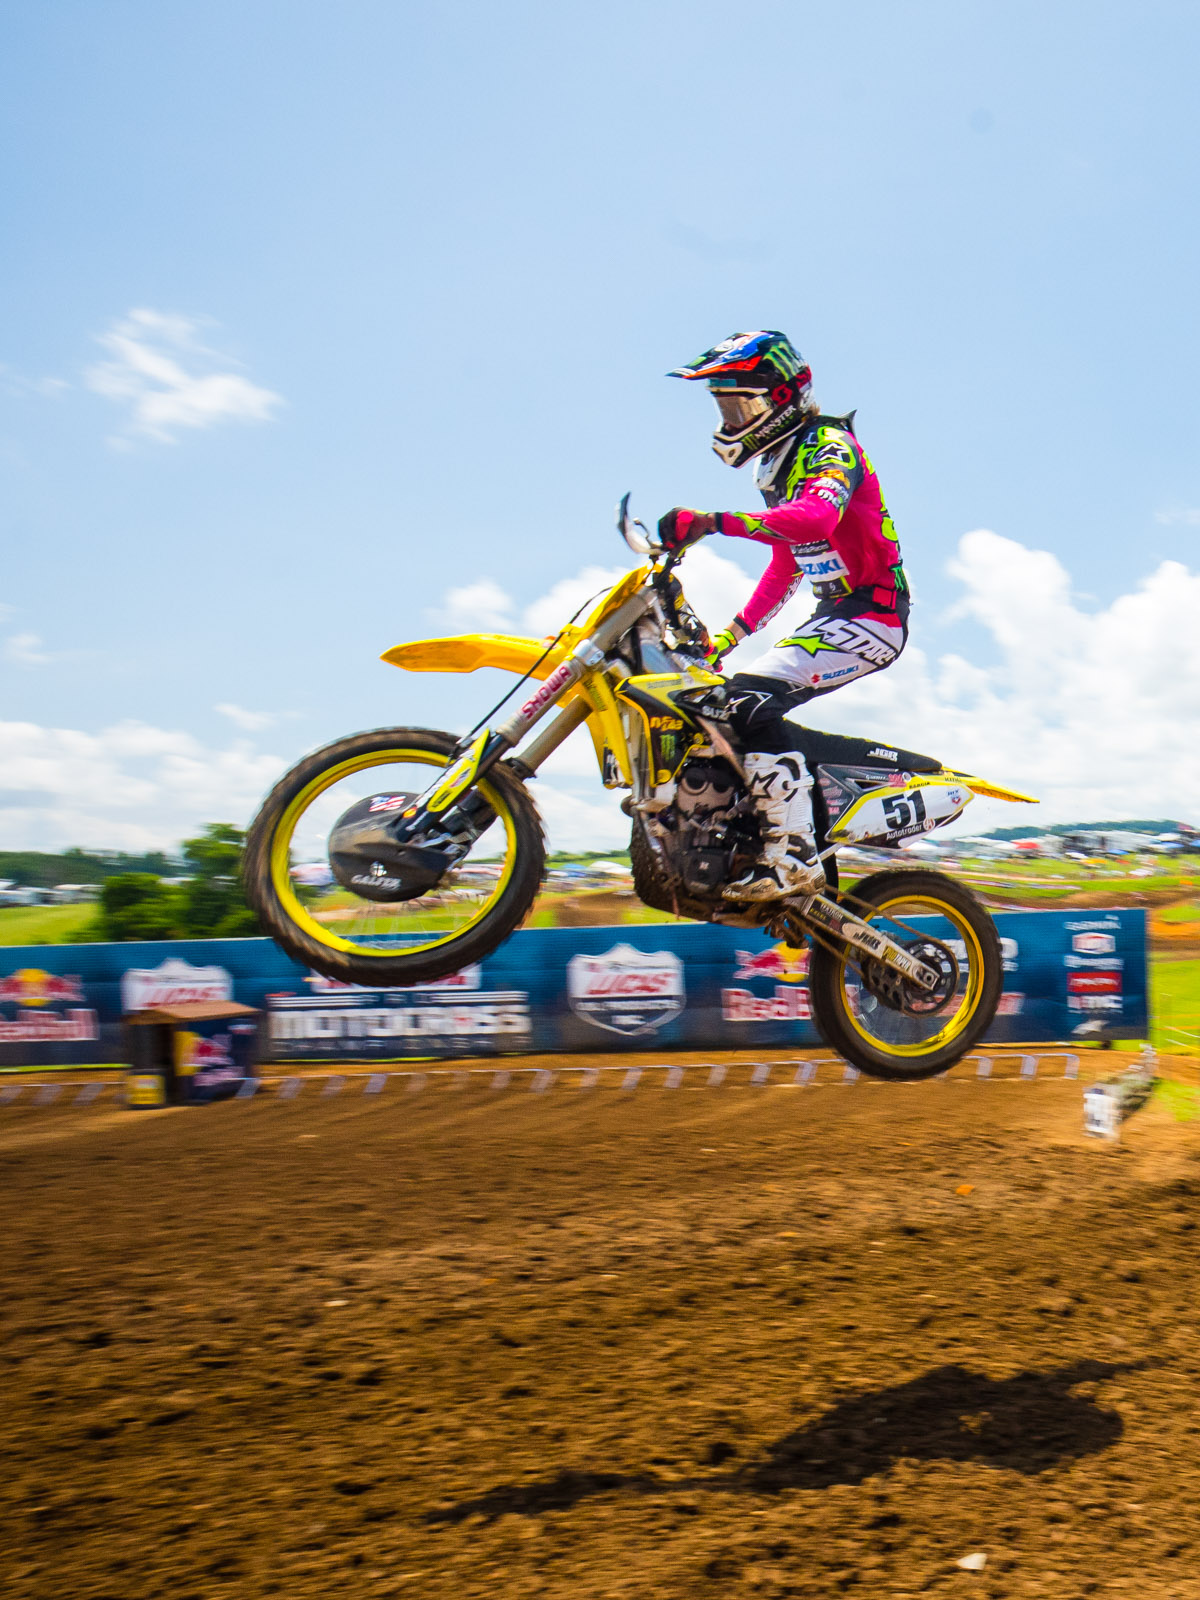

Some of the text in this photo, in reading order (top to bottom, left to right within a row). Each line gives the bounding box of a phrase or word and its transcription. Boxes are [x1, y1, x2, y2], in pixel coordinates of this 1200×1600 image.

[754, 404, 797, 438] MONSTER
[822, 665, 859, 681] SUZUKI
[521, 665, 574, 720] SHOWA
[702, 705, 728, 721] SUZ
[881, 789, 927, 831] 51
[886, 823, 923, 841] Autotrader
[586, 972, 678, 996] LUCAS
[268, 1004, 532, 1039] MOTOCROSS
